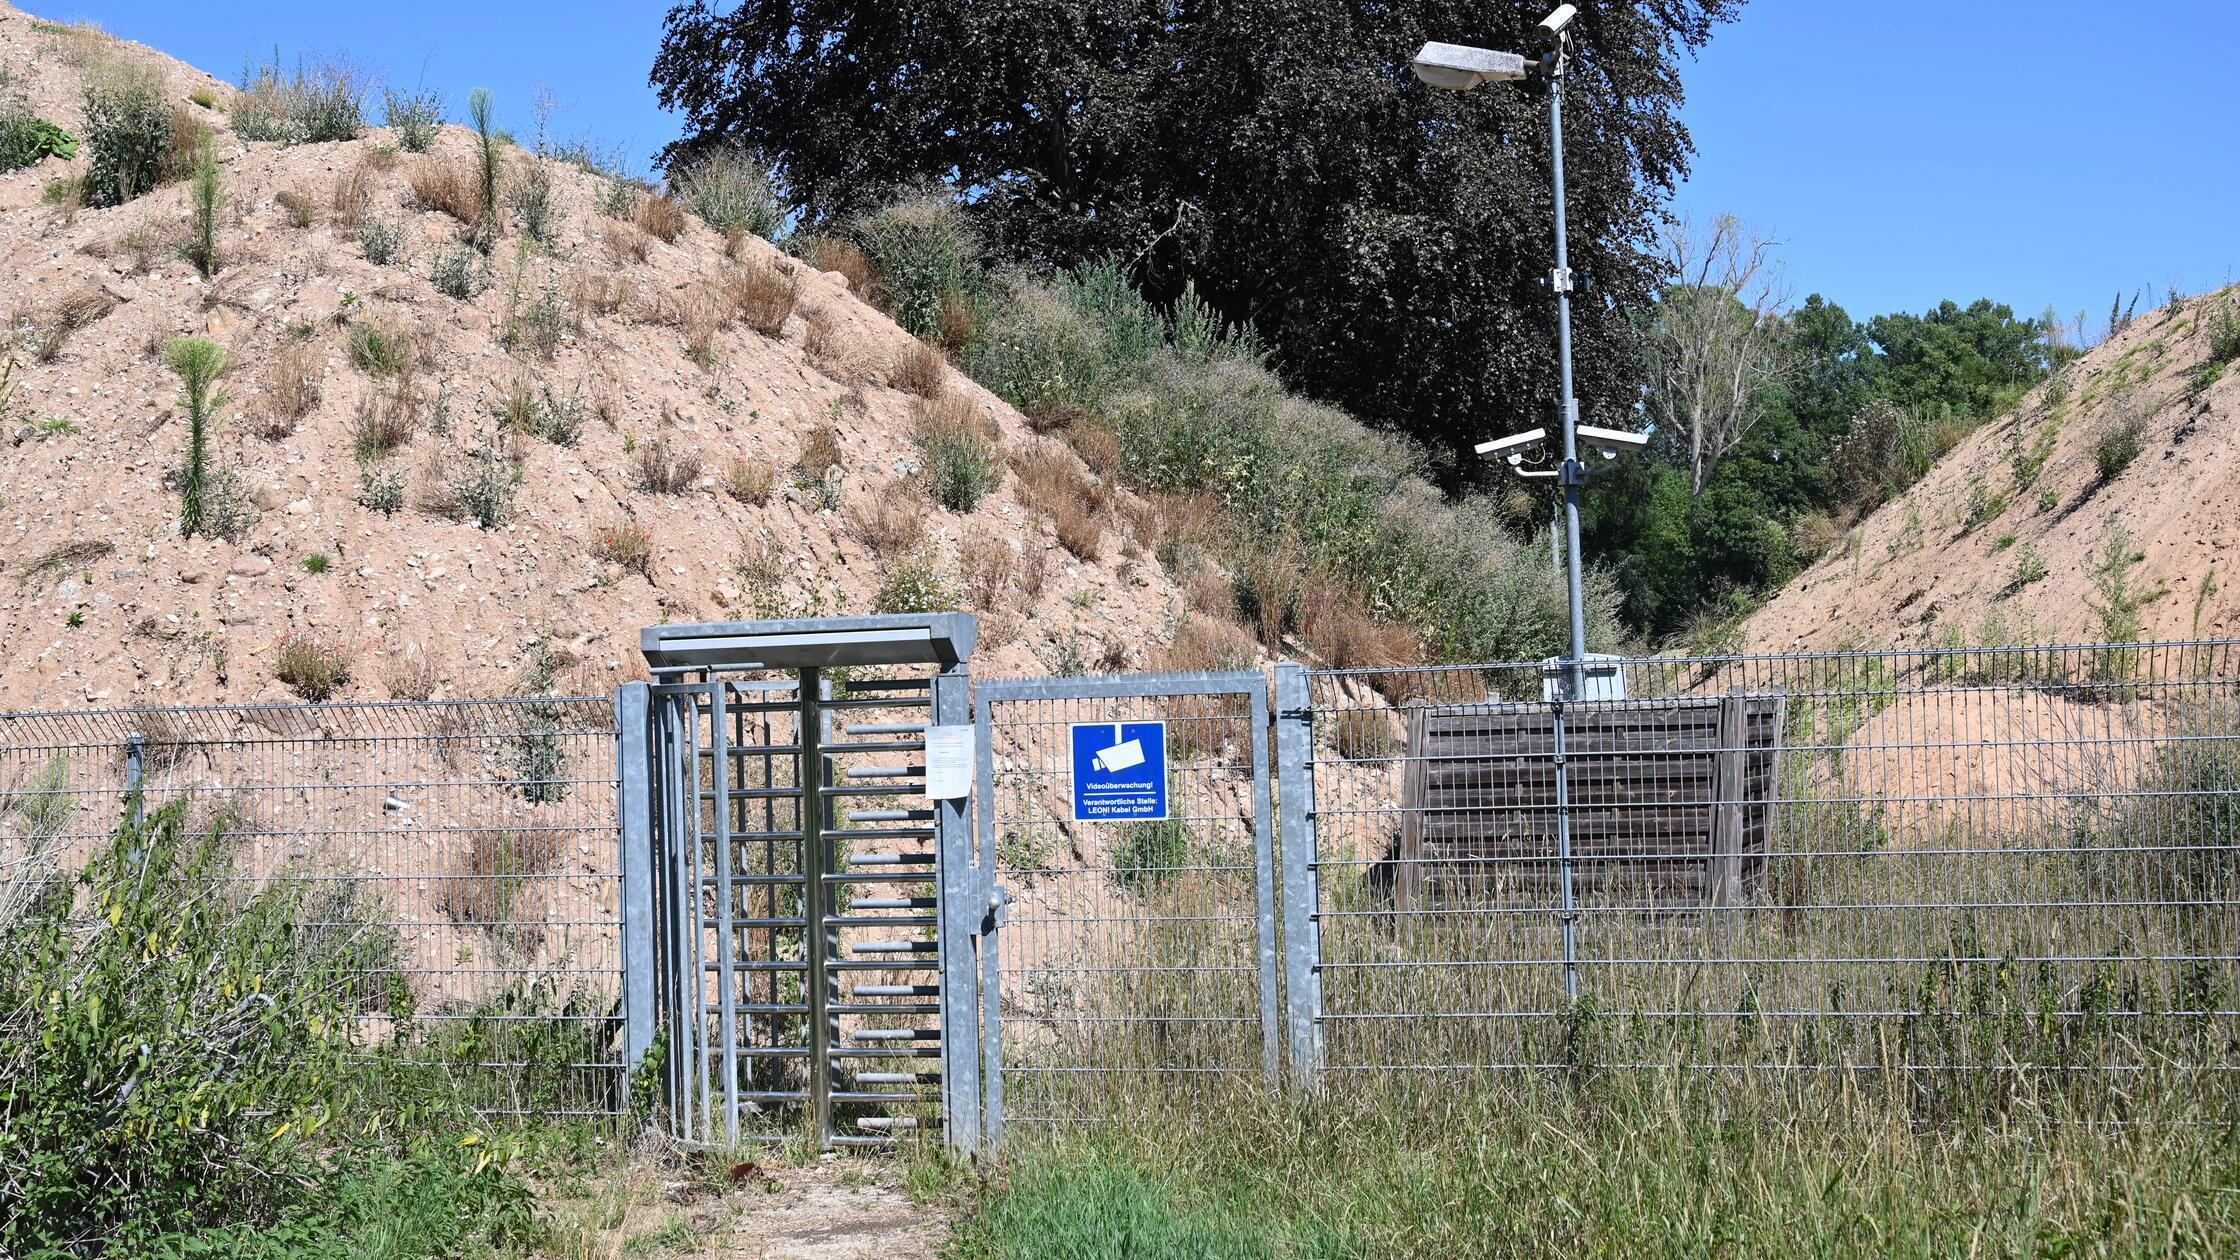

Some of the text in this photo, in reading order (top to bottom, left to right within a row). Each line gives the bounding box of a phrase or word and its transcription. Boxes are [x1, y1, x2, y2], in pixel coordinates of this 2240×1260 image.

[1086, 781, 1153, 790] Videoüberwachung!
[1083, 797, 1158, 806] Verantwortliche Stelle:
[1132, 805, 1154, 813] GmbH
